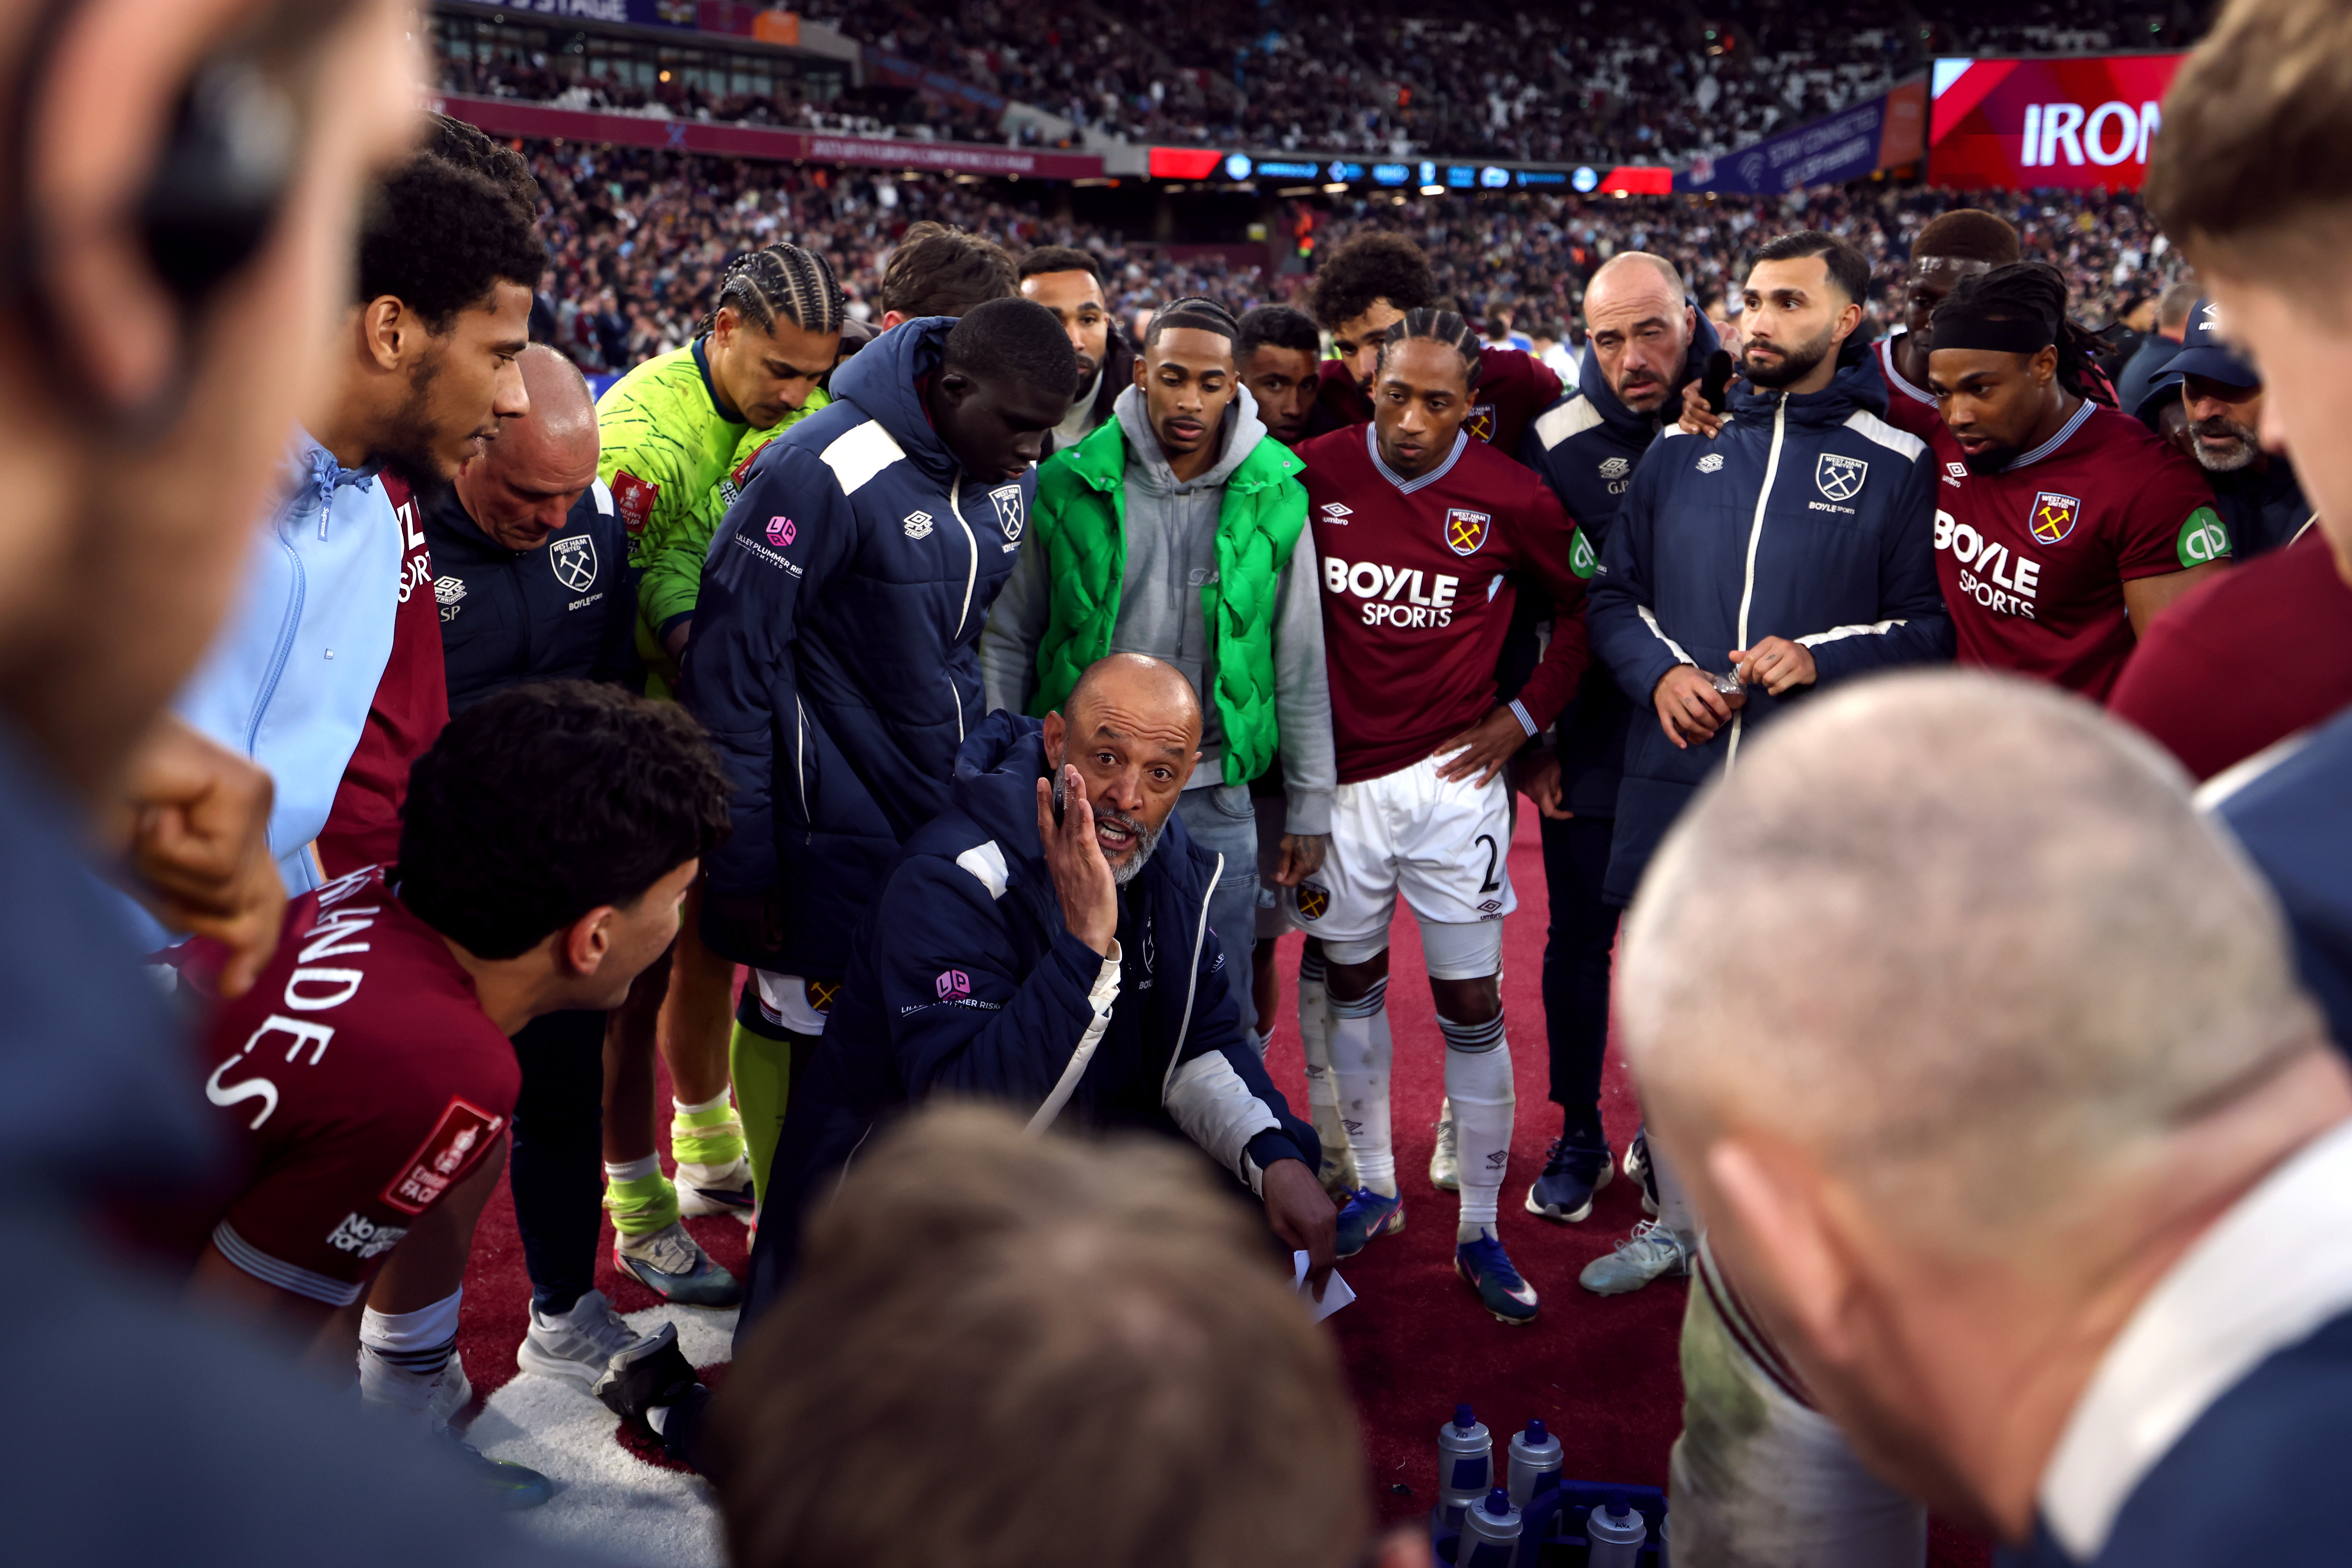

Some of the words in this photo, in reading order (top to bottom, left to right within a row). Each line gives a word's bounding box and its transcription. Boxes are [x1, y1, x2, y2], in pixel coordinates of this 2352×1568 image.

[1845, 460, 1862, 469] HAM
[1942, 474, 1961, 488] umbro
[994, 490, 1008, 499] WEST
[2061, 497, 2076, 506] HAM
[1809, 501, 1837, 513] BOYLE
[321, 506, 329, 537] Supreme
[1323, 517, 1348, 526] umbro
[1471, 514, 1486, 522] HAM
[553, 542, 568, 552] WEST
[570, 538, 587, 547] HAM
[560, 545, 581, 554] UNITED
[736, 533, 754, 546] LILLEY
[753, 543, 790, 568] PLUMMER
[790, 564, 804, 575] RISK
[752, 550, 783, 569] LIMITED
[1934, 508, 2040, 598] BOYLE
[1324, 556, 1459, 608] BOYLE
[436, 591, 465, 603] TRAINING
[1959, 568, 2036, 619] SPORTS
[569, 597, 591, 611] BOYLE
[440, 605, 461, 622] SP
[1361, 602, 1453, 628] SPORTS
[1475, 835, 1500, 893] 2
[1481, 912, 1502, 920] umbro
[1139, 979, 1153, 989] BOYL
[902, 1005, 924, 1013] LILL
